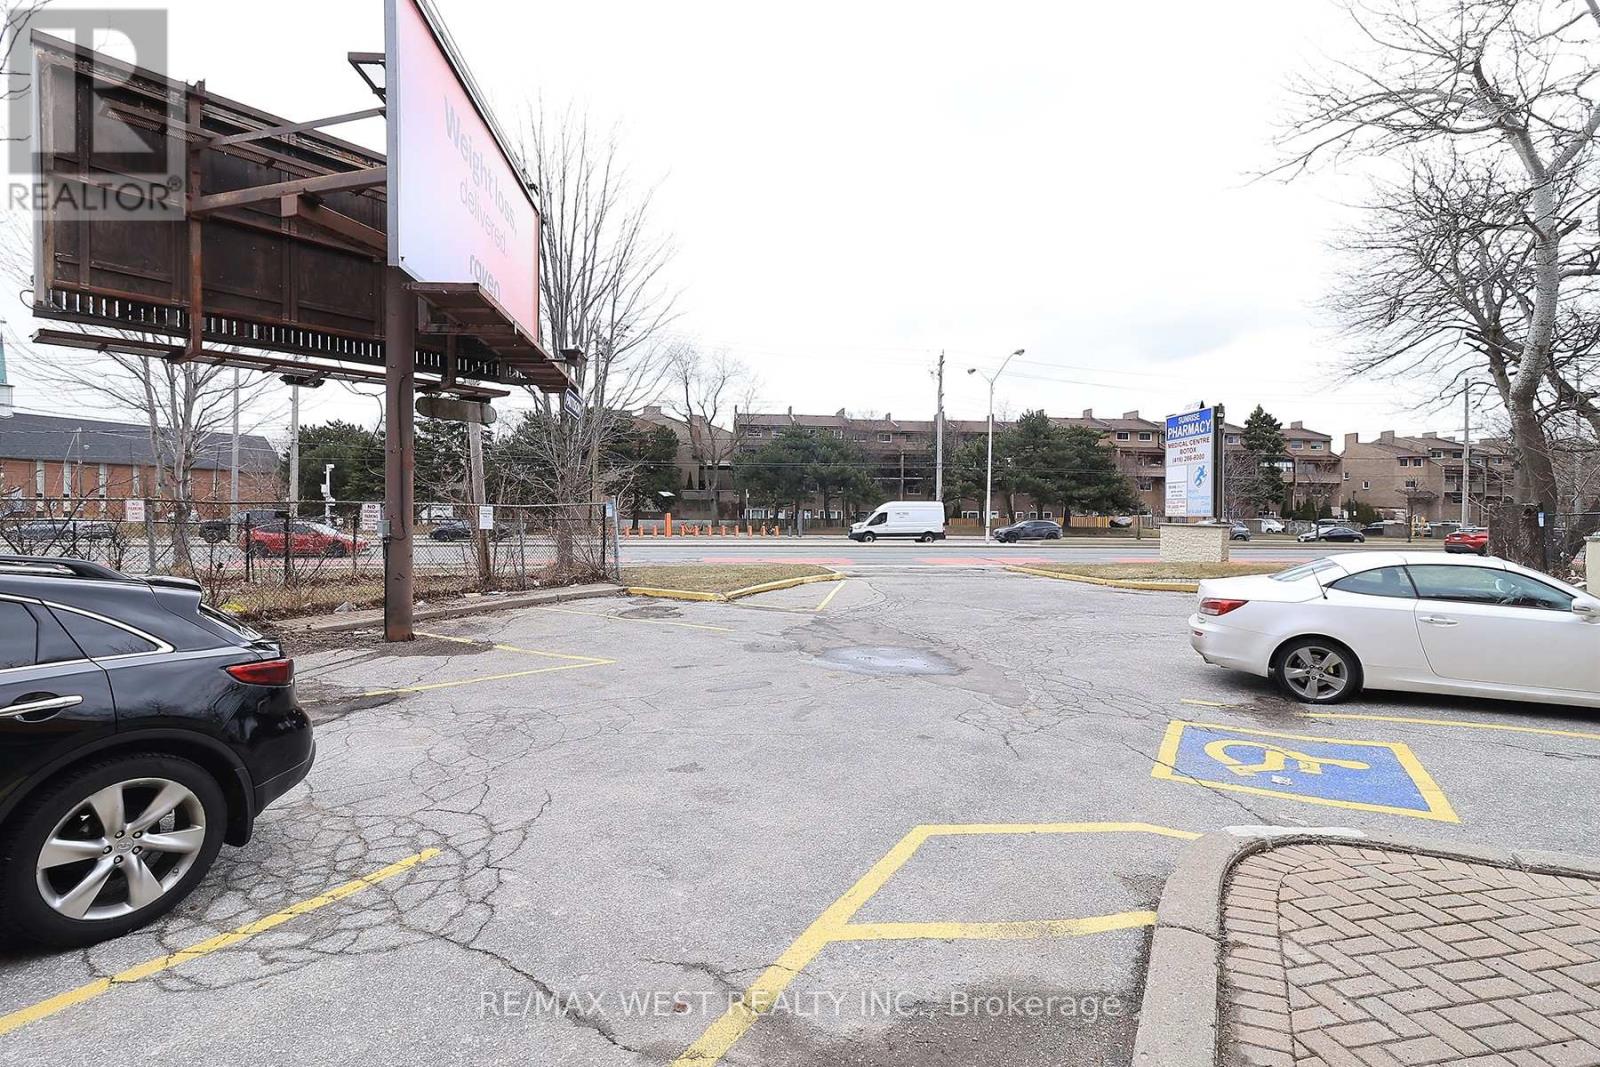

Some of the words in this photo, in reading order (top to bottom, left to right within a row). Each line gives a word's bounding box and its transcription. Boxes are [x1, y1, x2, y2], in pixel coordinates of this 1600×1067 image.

[444, 97, 495, 195] Weight
[469, 253, 500, 298] raven
[1178, 413, 1201, 424] SUNRISE
[1168, 420, 1211, 440] PHARMACY
[1168, 441, 1188, 449] MEDICAL
[1189, 437, 1210, 446] CENTRE
[1179, 447, 1197, 455] BOTOX
